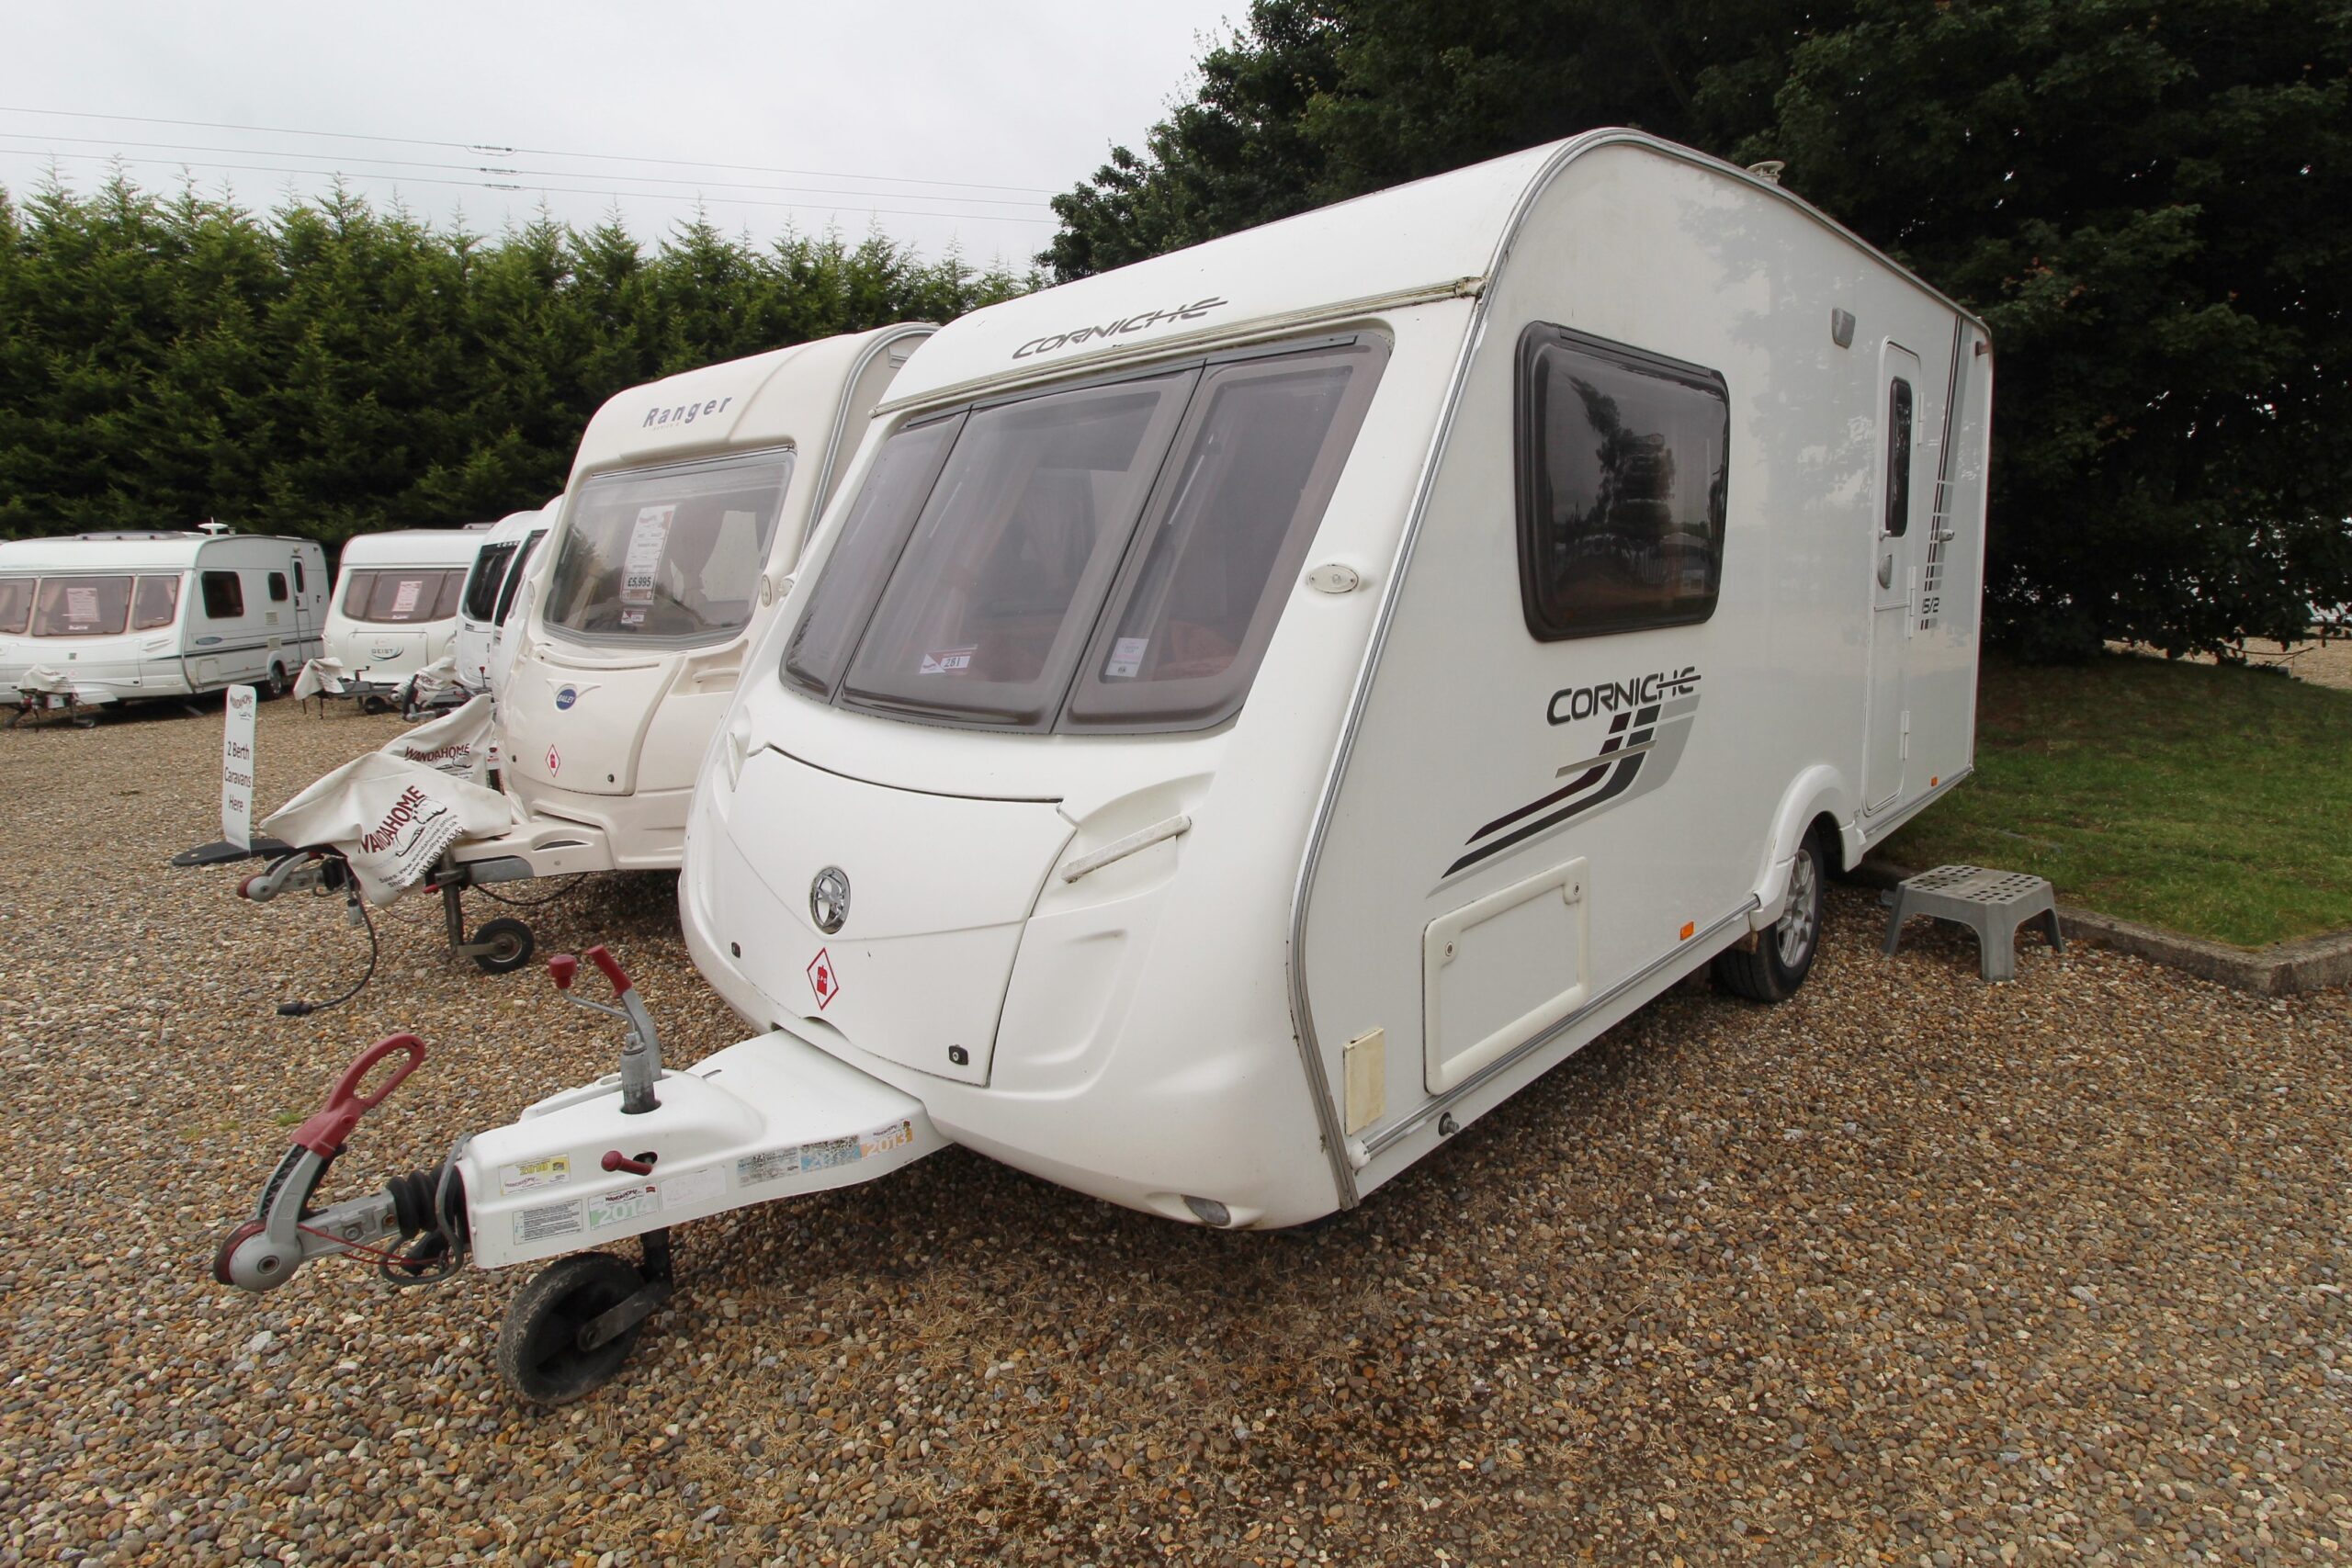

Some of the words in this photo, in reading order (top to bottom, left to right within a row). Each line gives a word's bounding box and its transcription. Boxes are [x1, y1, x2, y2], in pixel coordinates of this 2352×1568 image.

[1012, 296, 1228, 359] CORNICHE
[642, 396, 732, 428] Ranger
[628, 576, 651, 588] £5,995
[1546, 666, 1702, 727] CORNICHE
[227, 740, 232, 757] 2
[232, 742, 250, 761] Berth
[404, 743, 470, 762] WANDAHOME
[224, 766, 252, 788] Caravans
[229, 794, 243, 813] Here
